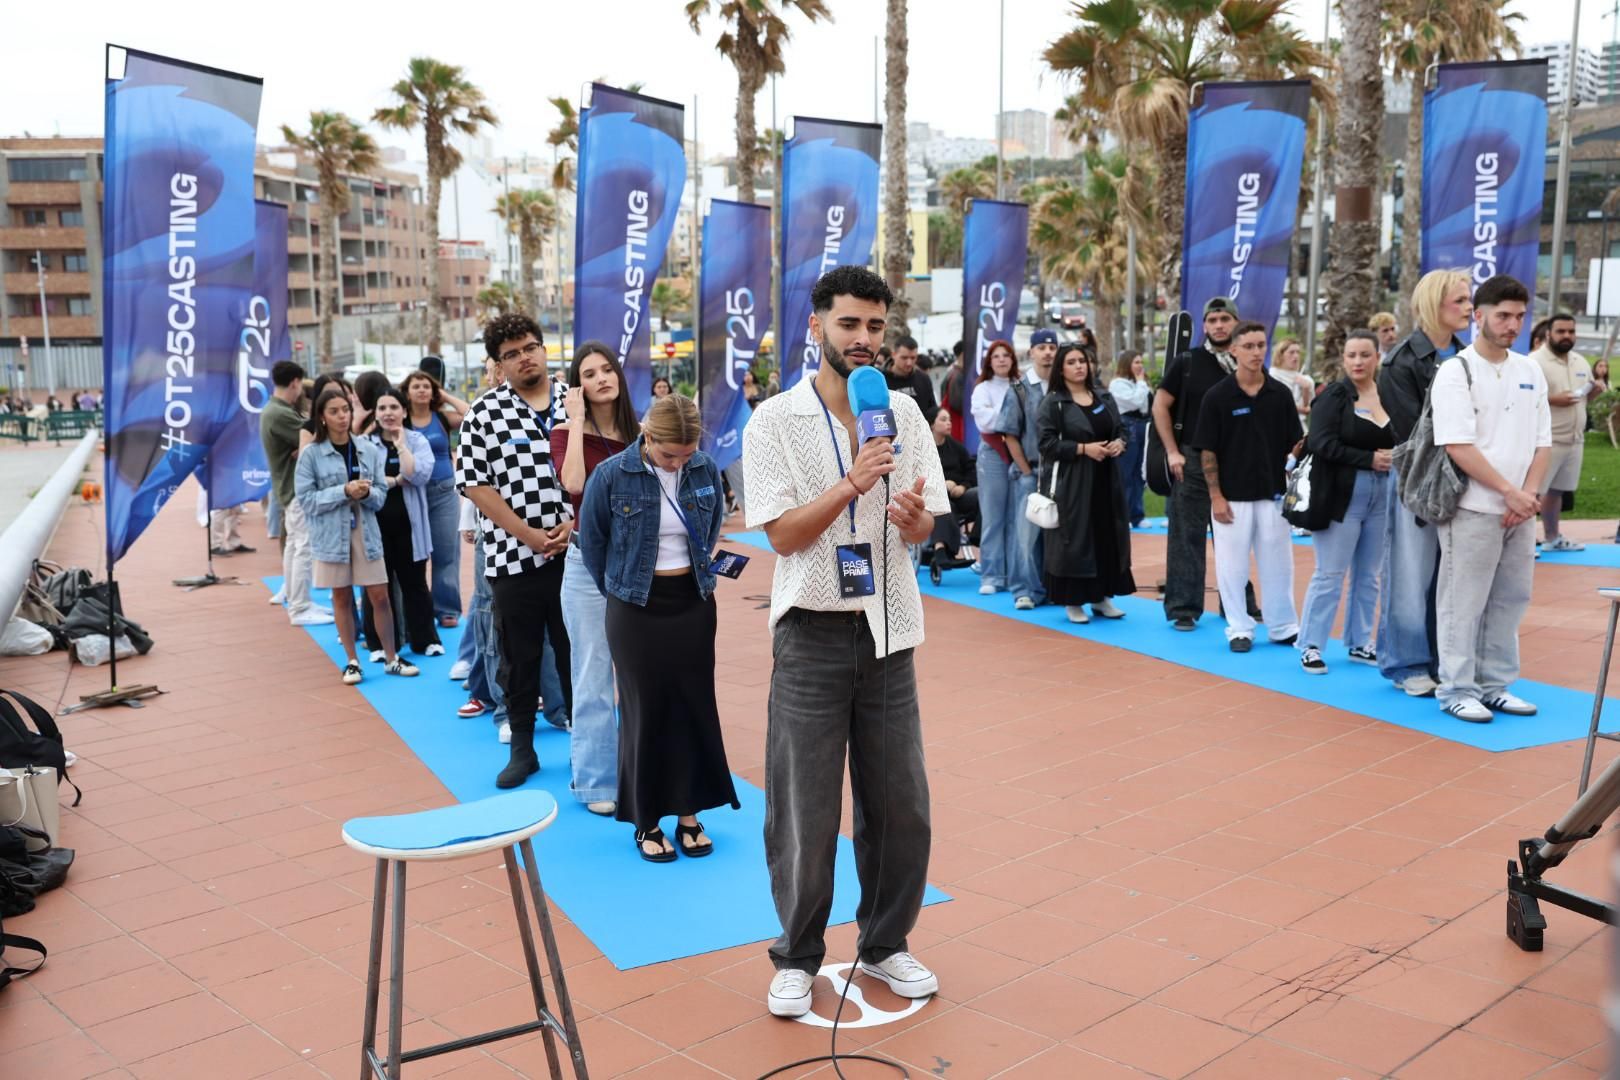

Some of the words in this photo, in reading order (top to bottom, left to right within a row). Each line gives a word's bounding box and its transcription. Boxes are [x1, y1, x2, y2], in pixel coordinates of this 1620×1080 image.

[1471, 152, 1499, 300] CASTING
[160, 172, 199, 461] #OT25CASTING
[842, 560, 868, 570] PASE
[843, 566, 870, 577] PRIME
